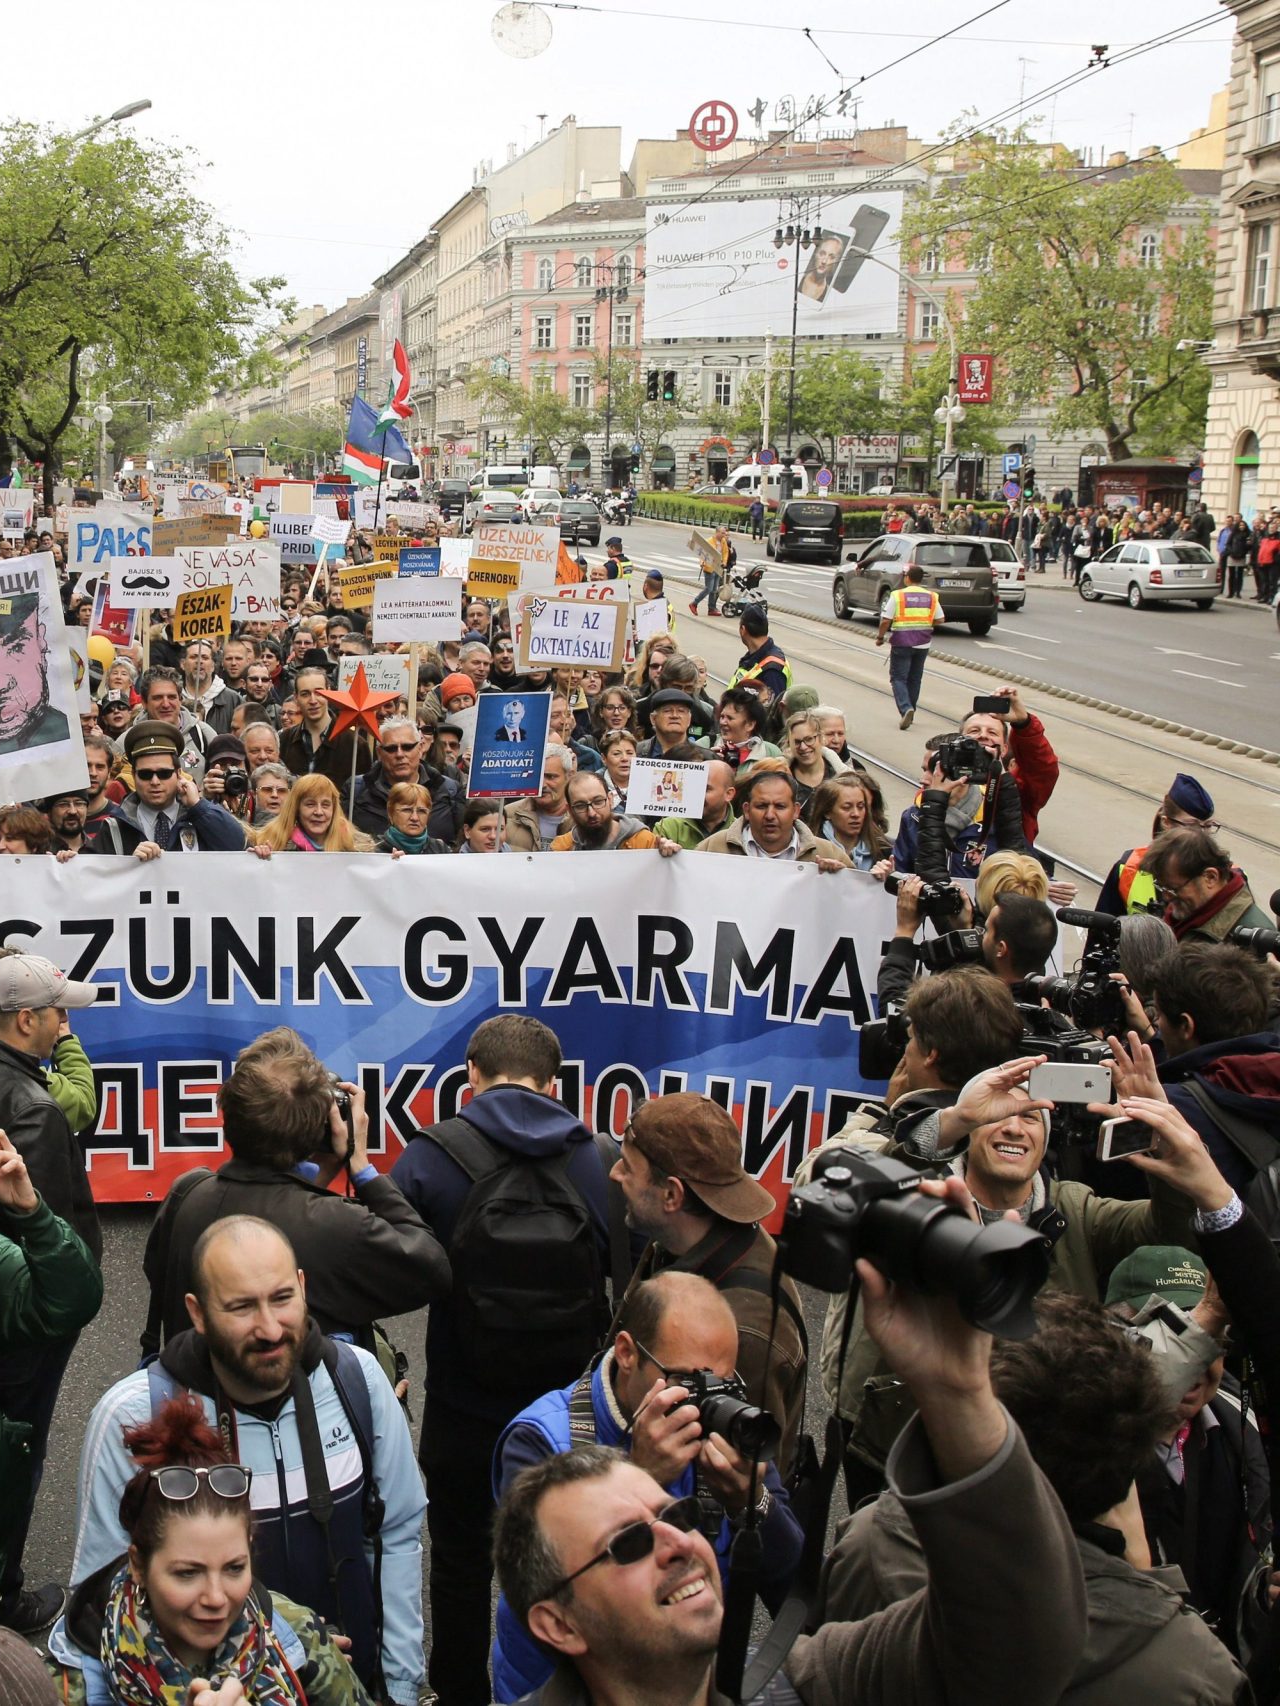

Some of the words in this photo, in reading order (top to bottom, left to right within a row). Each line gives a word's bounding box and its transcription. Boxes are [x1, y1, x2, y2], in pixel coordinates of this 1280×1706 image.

[672, 215, 706, 223] HUAWEI
[657, 252, 704, 263] HUAWEI
[708, 252, 726, 260] P10
[734, 251, 752, 260] P10
[756, 249, 776, 259] Plus
[76, 522, 150, 563] PAKS
[469, 570, 517, 586] CHERNOBYL
[181, 594, 225, 616] ÉSZAK-
[180, 615, 224, 637] KOREA
[553, 609, 569, 627] LE
[582, 611, 601, 630] AZ
[531, 634, 611, 659] OKTATÁSAL!
[481, 759, 533, 768] ADATOKAT!
[402, 912, 890, 1029] GYARMA
